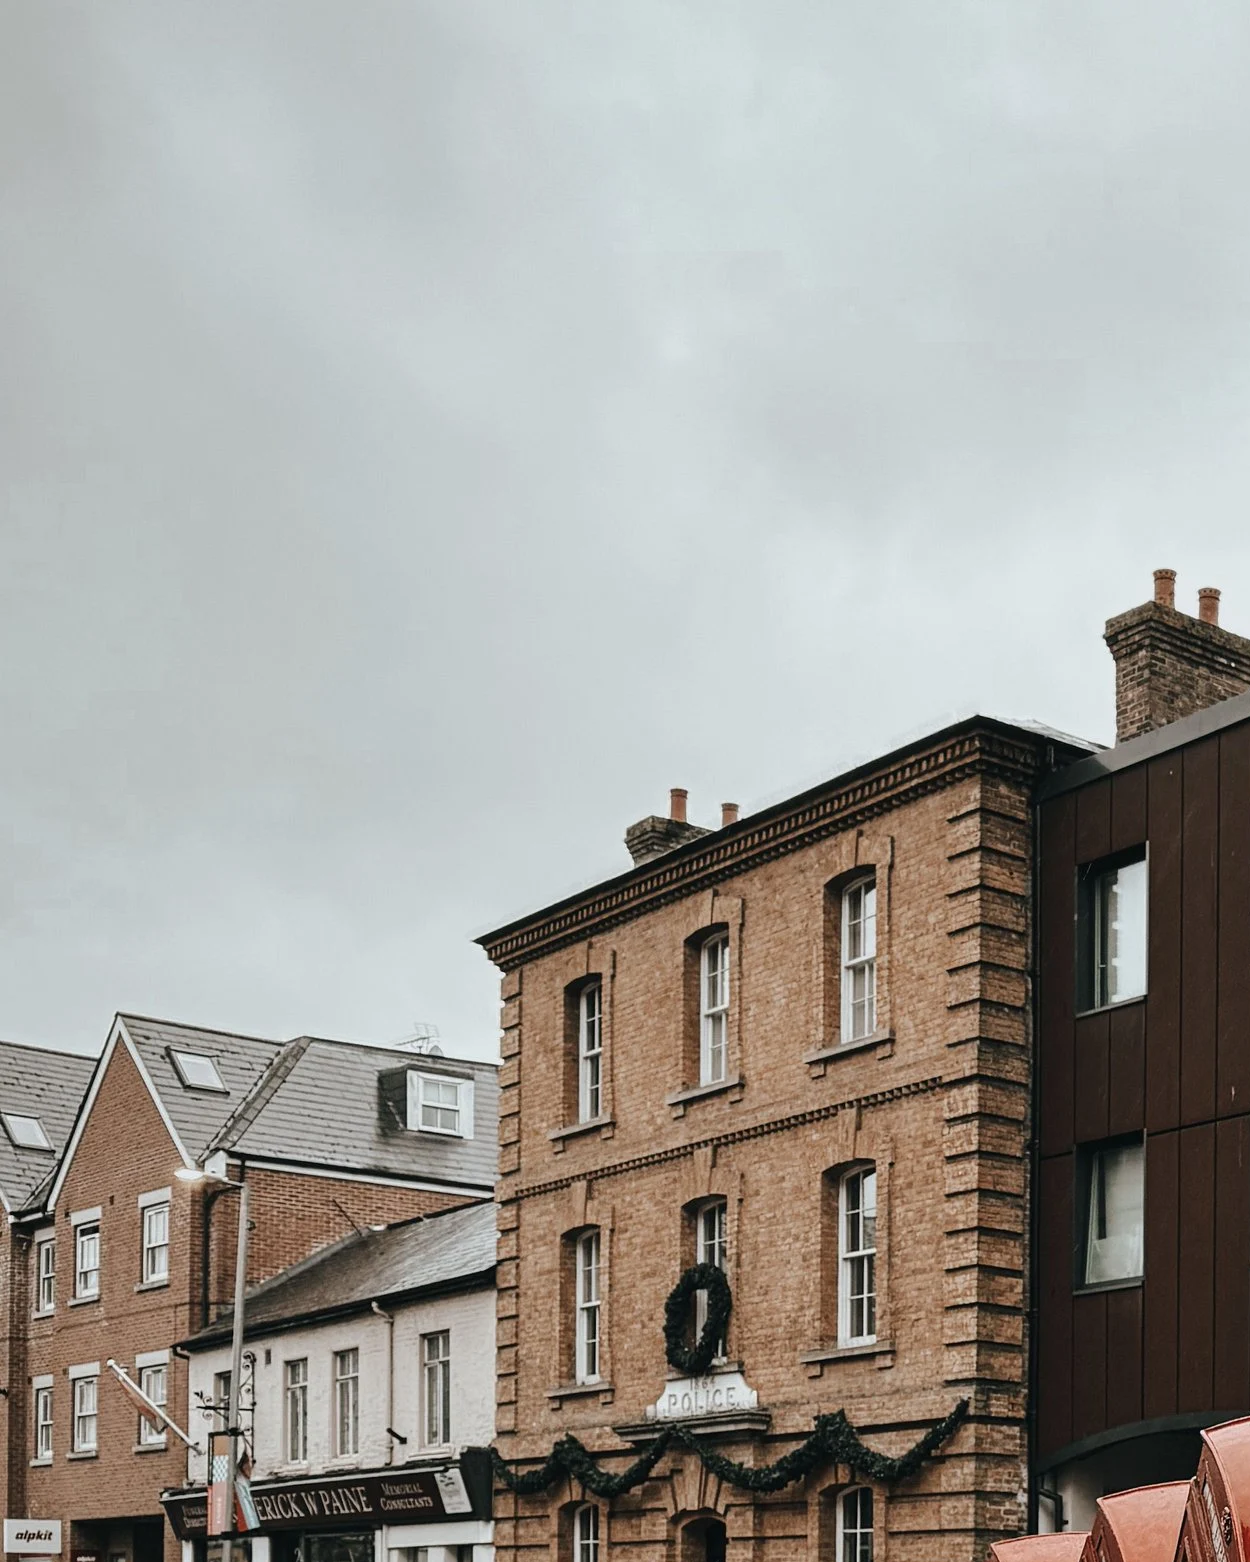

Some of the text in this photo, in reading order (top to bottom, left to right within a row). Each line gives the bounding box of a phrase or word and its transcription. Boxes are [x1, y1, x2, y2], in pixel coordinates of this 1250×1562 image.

[668, 1386, 737, 1413] POLICE
[300, 1490, 319, 1516] W
[319, 1486, 373, 1516] PAINE
[15, 1529, 53, 1543] alpkit
